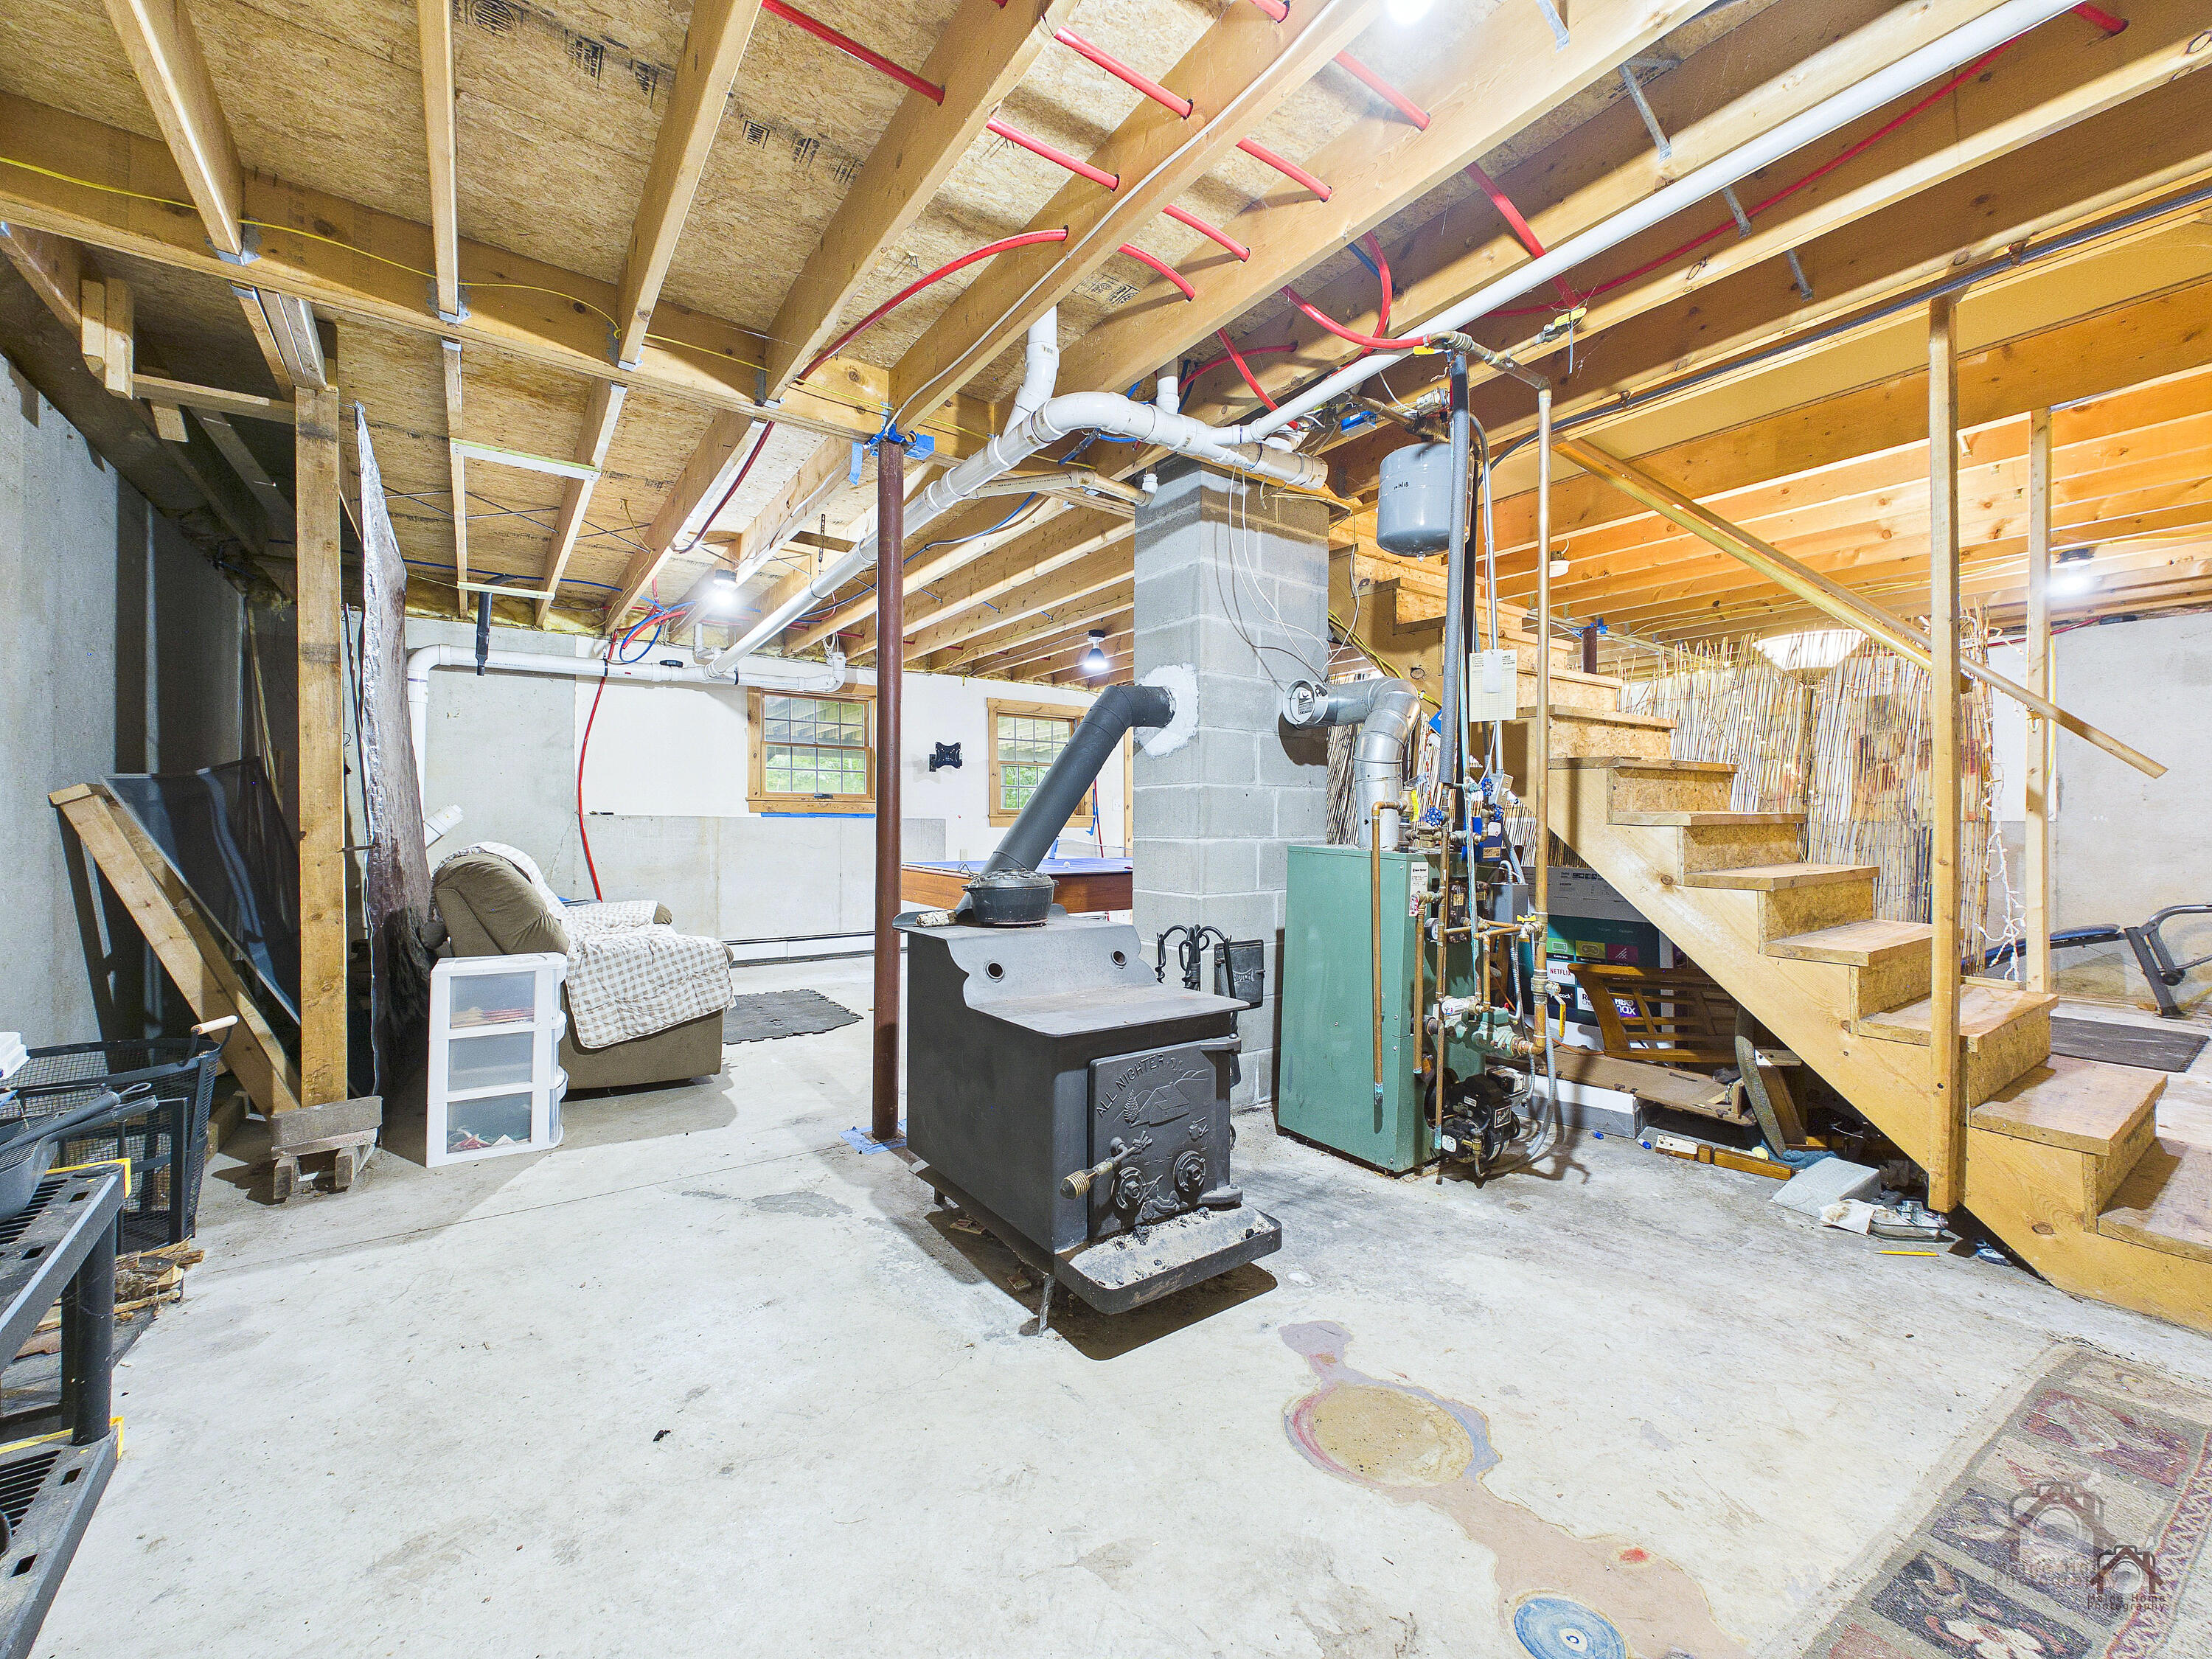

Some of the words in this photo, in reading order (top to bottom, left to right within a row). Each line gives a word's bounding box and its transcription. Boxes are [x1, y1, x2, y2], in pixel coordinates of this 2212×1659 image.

[1550, 967, 1571, 977] NETFLIX
[1614, 998, 1634, 1007] HBO
[1096, 1091, 1118, 1118] ALL
[1115, 1053, 1164, 1091] NIGHTER
